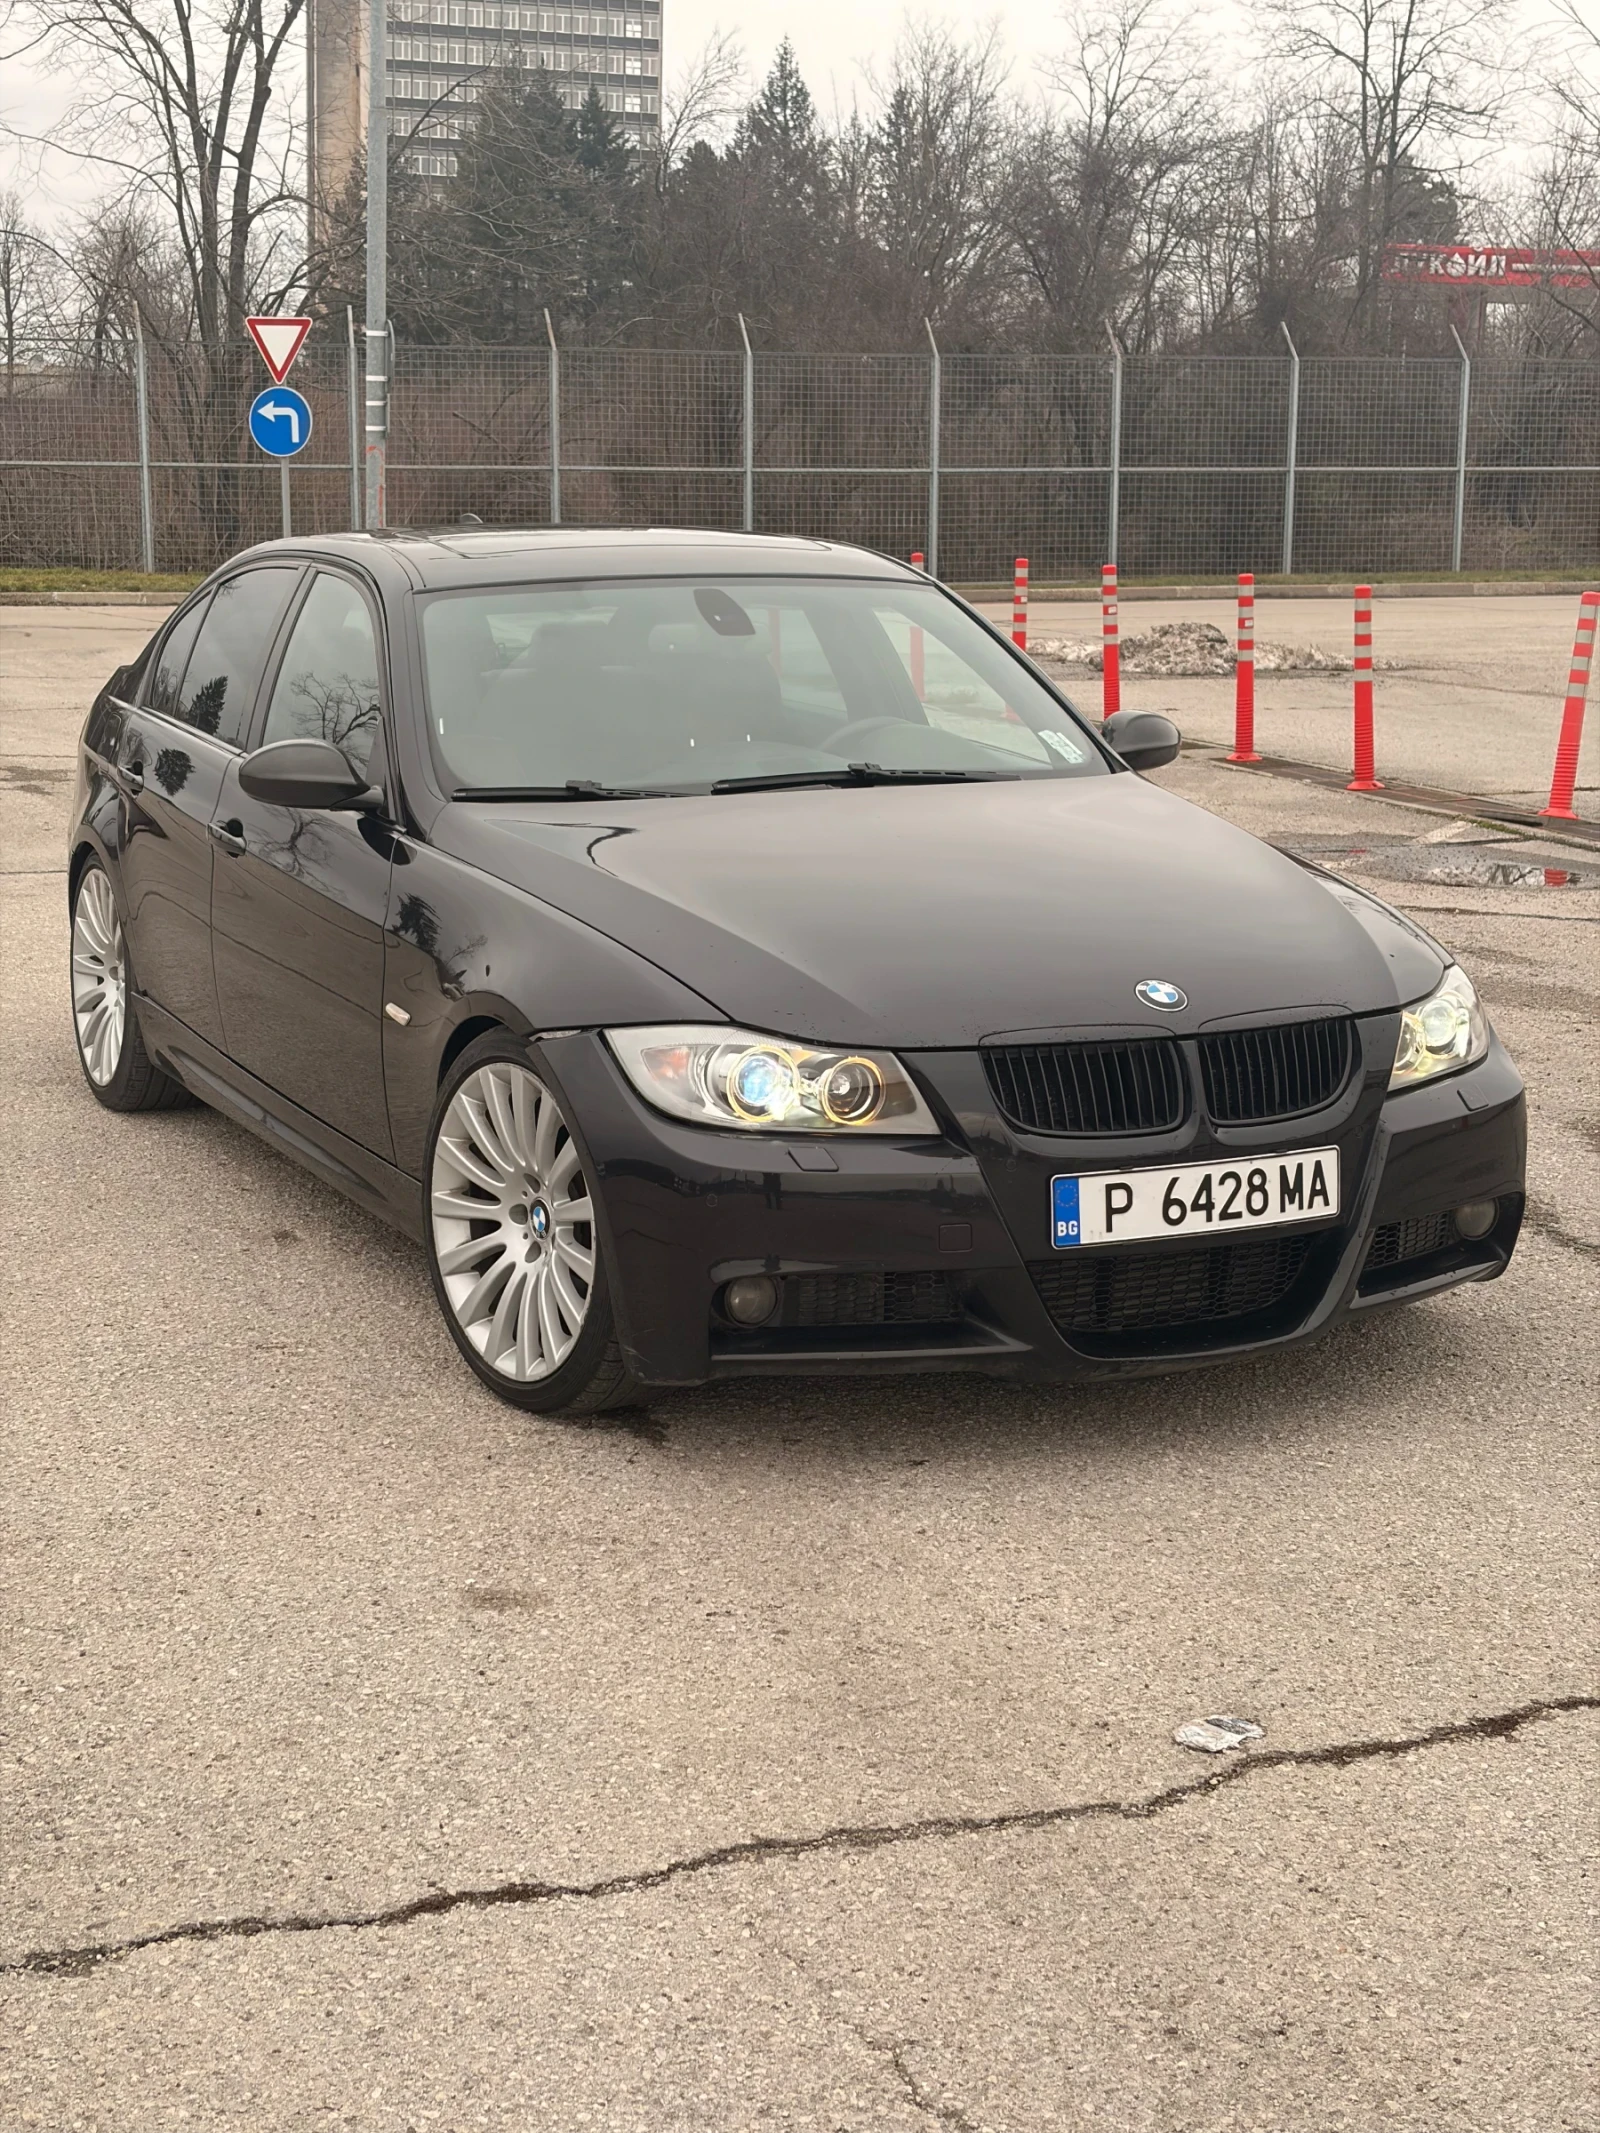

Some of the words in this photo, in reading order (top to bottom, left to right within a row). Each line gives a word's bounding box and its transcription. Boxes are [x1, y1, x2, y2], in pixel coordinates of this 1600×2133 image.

[1105, 1182, 1133, 1233] P
[1161, 1168, 1269, 1226] 6428
[1279, 1160, 1330, 1213] MA
[1057, 1221, 1078, 1237] BG
